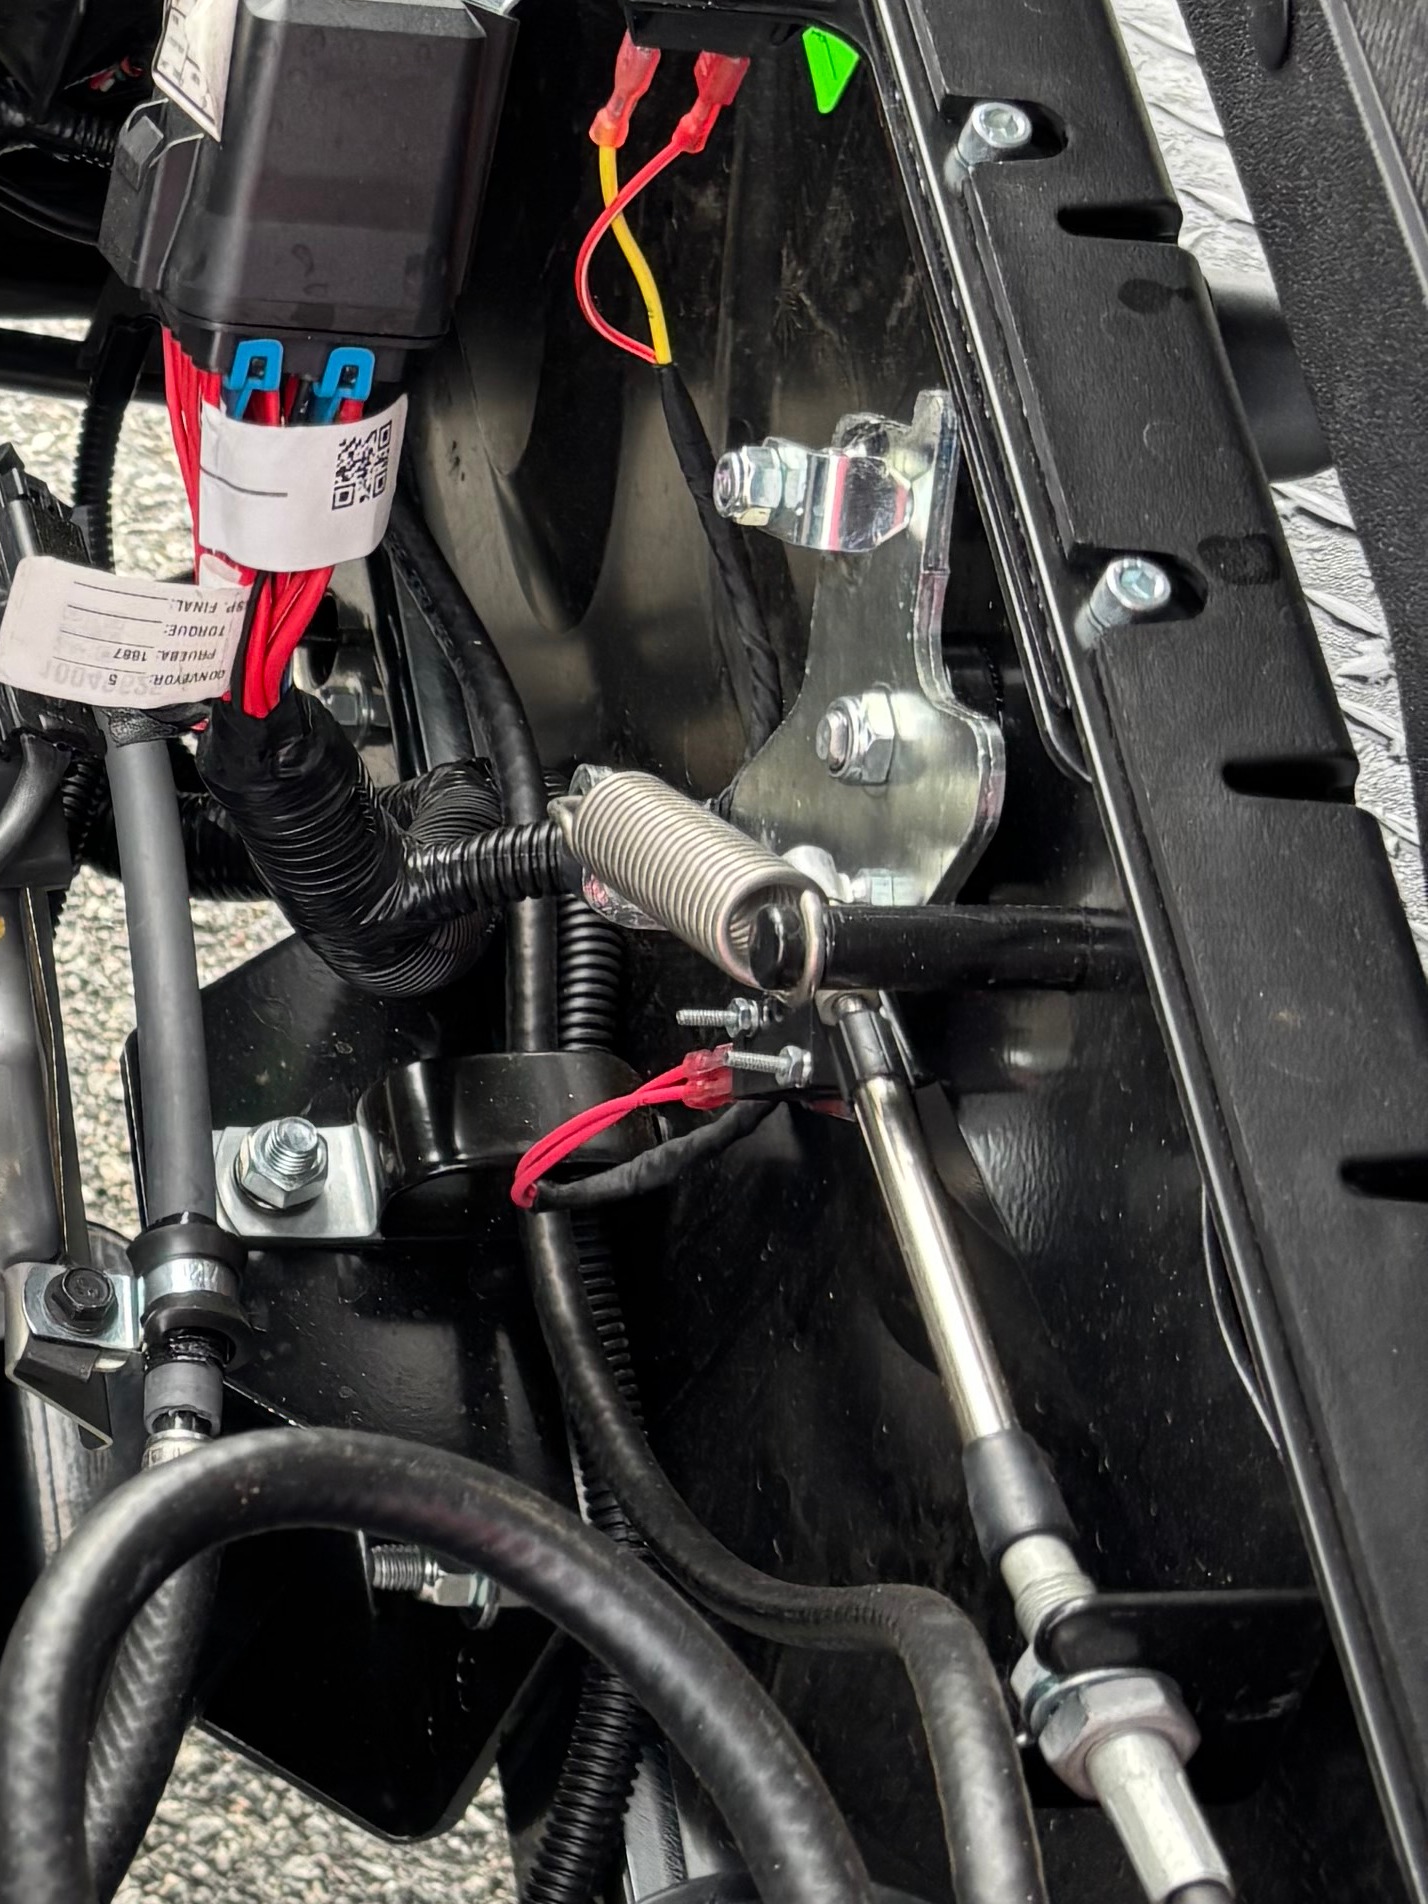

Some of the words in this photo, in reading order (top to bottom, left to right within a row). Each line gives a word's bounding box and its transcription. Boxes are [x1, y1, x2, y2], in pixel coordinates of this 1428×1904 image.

[223, 599, 247, 613] SP.
[163, 623, 225, 636] TORQUE:
[106, 672, 118, 686] 5
